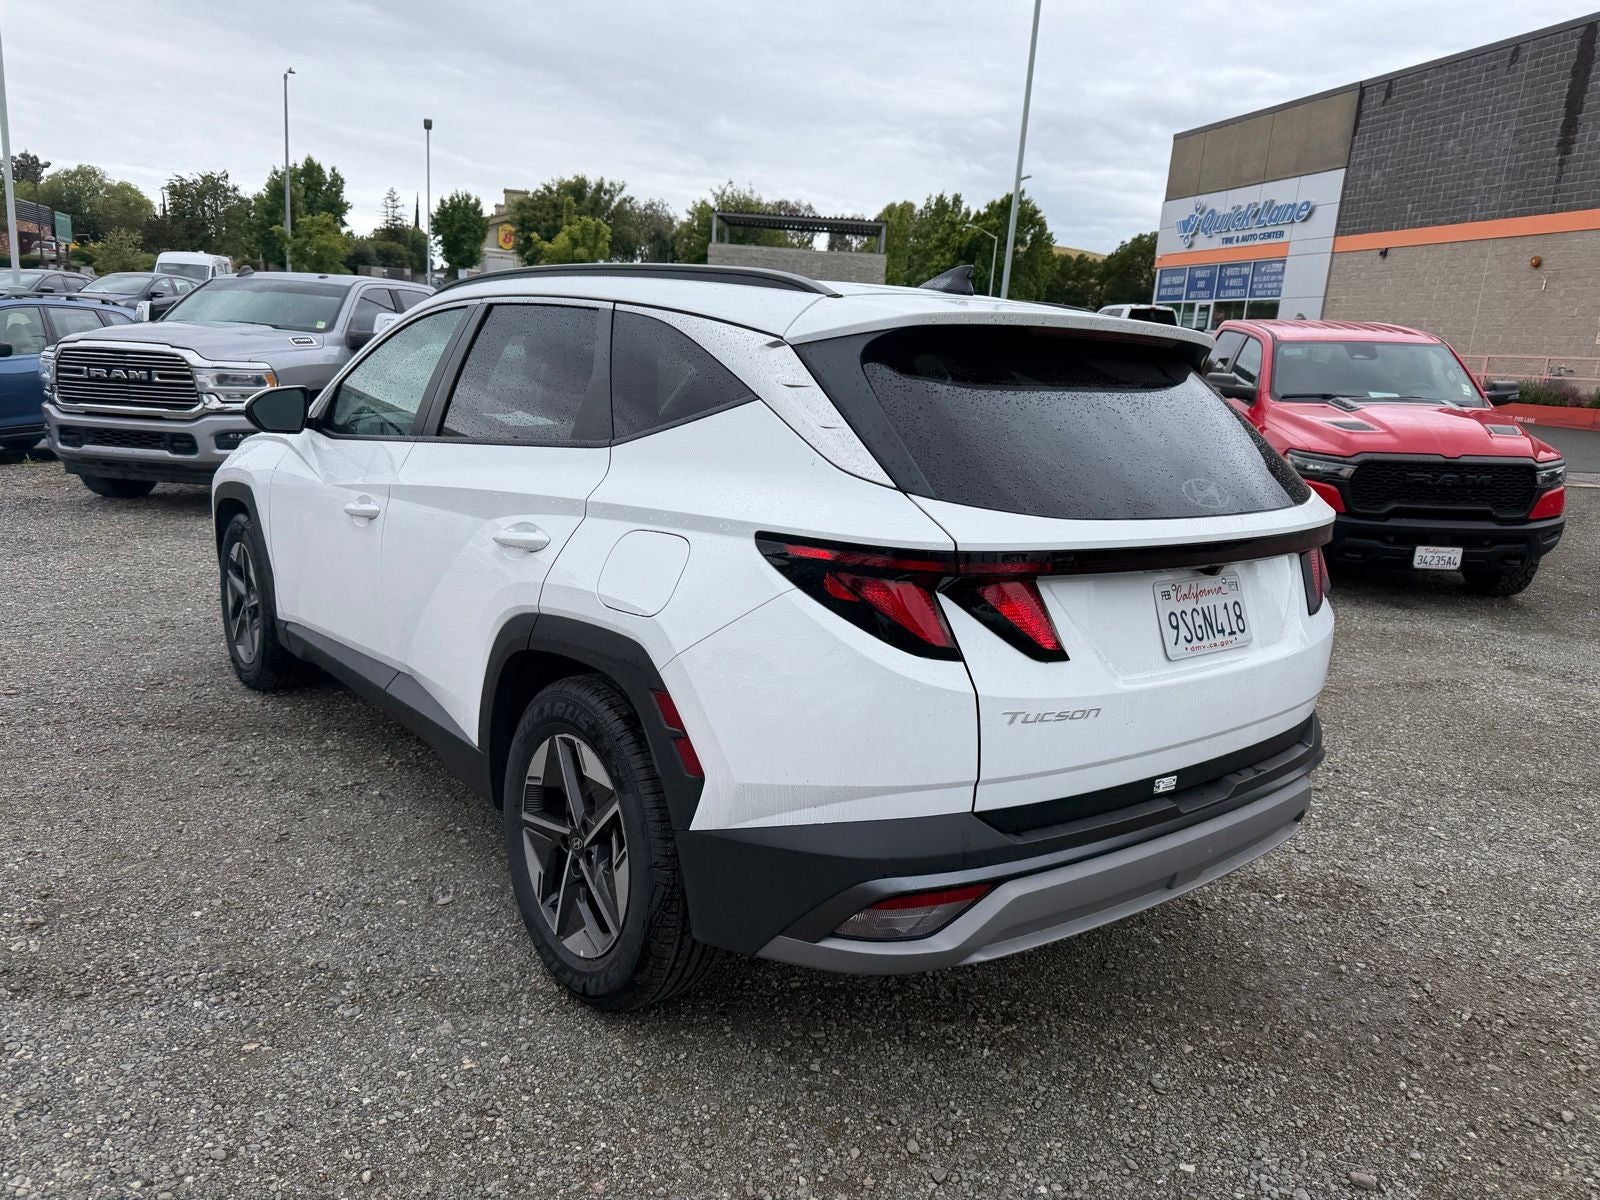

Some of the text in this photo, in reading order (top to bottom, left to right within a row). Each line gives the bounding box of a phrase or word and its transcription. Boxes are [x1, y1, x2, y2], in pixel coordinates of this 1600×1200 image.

[1200, 200, 1312, 235] Quick Lane
[1222, 236, 1235, 245] TIRE
[1239, 234, 1258, 242] AUTO
[1259, 231, 1285, 240] CENTER
[1162, 277, 1172, 286] FREE
[1220, 289, 1245, 297] ALIGNMENTS
[89, 368, 149, 381] RAM
[1406, 473, 1492, 486] RAM
[1417, 555, 1457, 566] 34235A4
[1161, 590, 1171, 601] FEB
[1175, 582, 1228, 605] California
[1168, 600, 1246, 646] 9SGN418
[1190, 639, 1233, 652] dmv.ca.gov
[1002, 707, 1102, 726] Tucson
